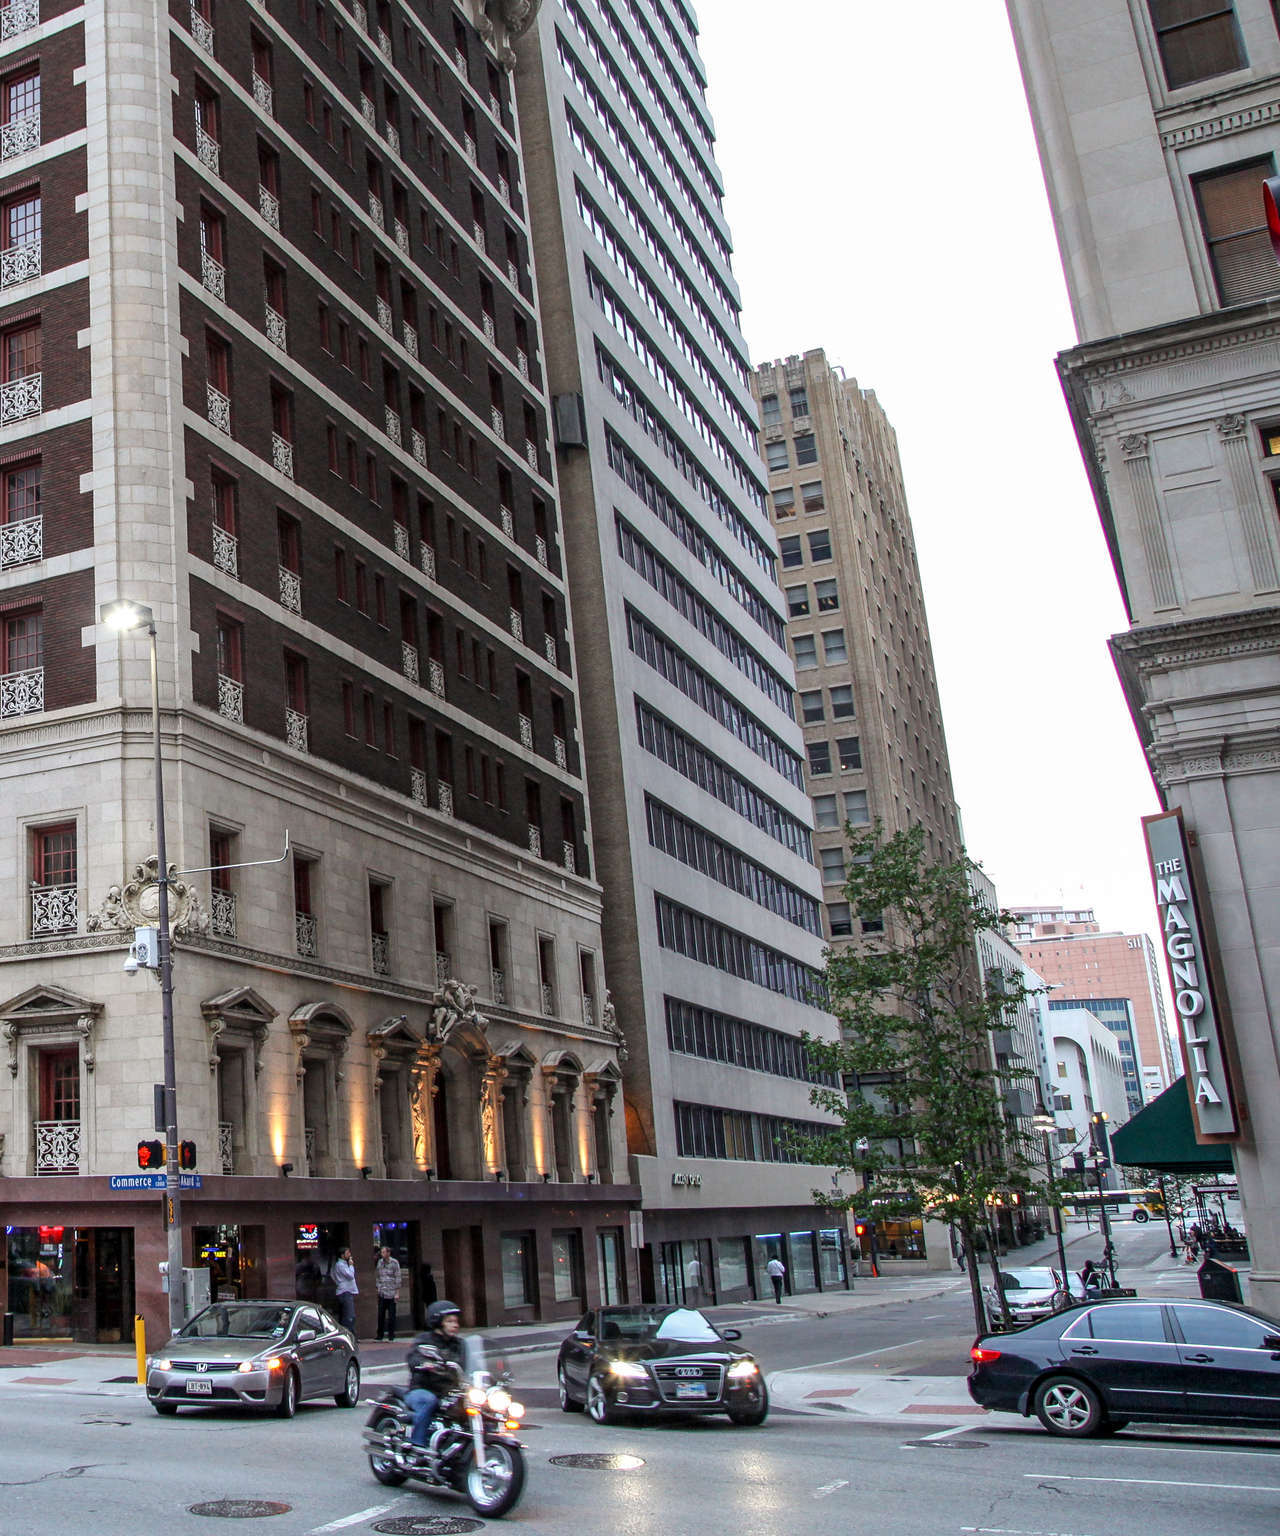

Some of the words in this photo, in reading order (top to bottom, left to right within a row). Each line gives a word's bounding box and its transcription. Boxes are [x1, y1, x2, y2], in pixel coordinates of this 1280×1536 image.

[1156, 858, 1181, 875] THE
[1157, 876, 1222, 1104] MAGNOLIA
[111, 1176, 152, 1188] Commerce
[181, 1176, 194, 1186] Akard
